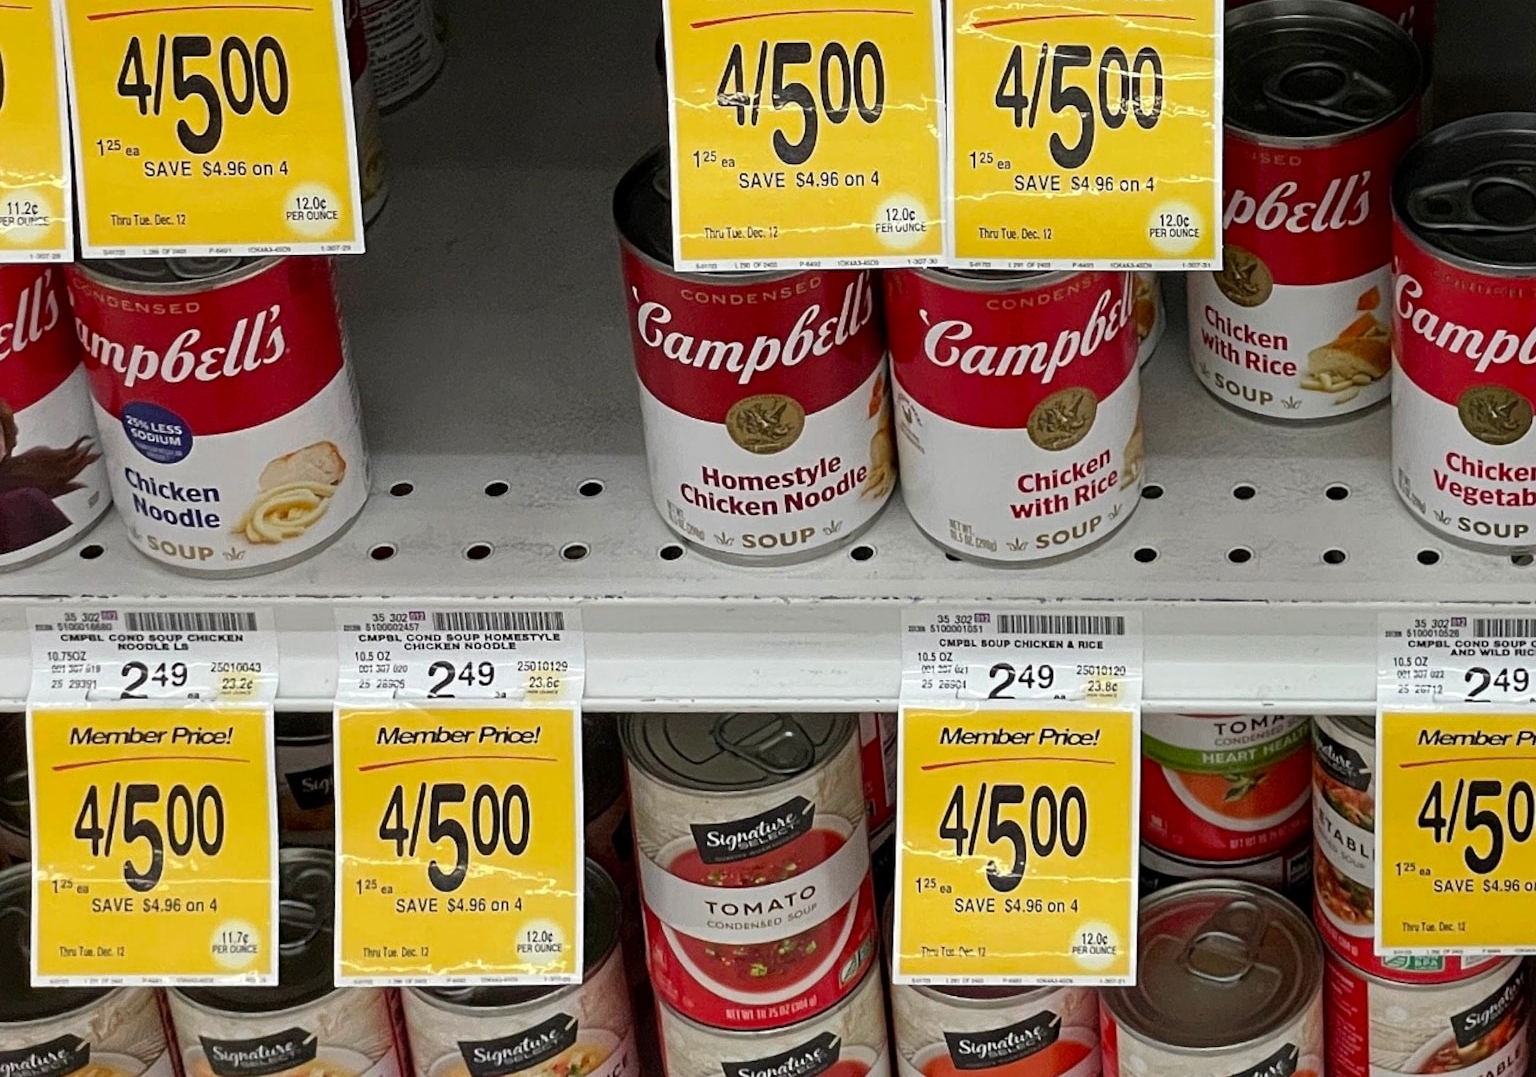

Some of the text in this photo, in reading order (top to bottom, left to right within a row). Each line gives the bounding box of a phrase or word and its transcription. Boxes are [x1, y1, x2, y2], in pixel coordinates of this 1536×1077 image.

[125, 467, 220, 503] Chicken
[701, 455, 841, 492] Homestyle
[1017, 449, 1111, 493] Chicken
[681, 463, 867, 515] Chicken Noodle
[1010, 468, 1117, 519] with Rice
[133, 493, 220, 528] Noodle
[742, 526, 815, 549] SOUP
[1458, 516, 1529, 539] SOUP
[147, 535, 213, 560] SOUP
[939, 639, 1103, 649] CMPBL SOUP CHICKEN & RICE
[1418, 730, 1514, 747] Member
[1202, 747, 1255, 765] HEART
[707, 811, 797, 850] Signature
[704, 885, 817, 917] TOMATO
[1434, 879, 1473, 892] SAVE
[1483, 878, 1519, 893] $4.96
